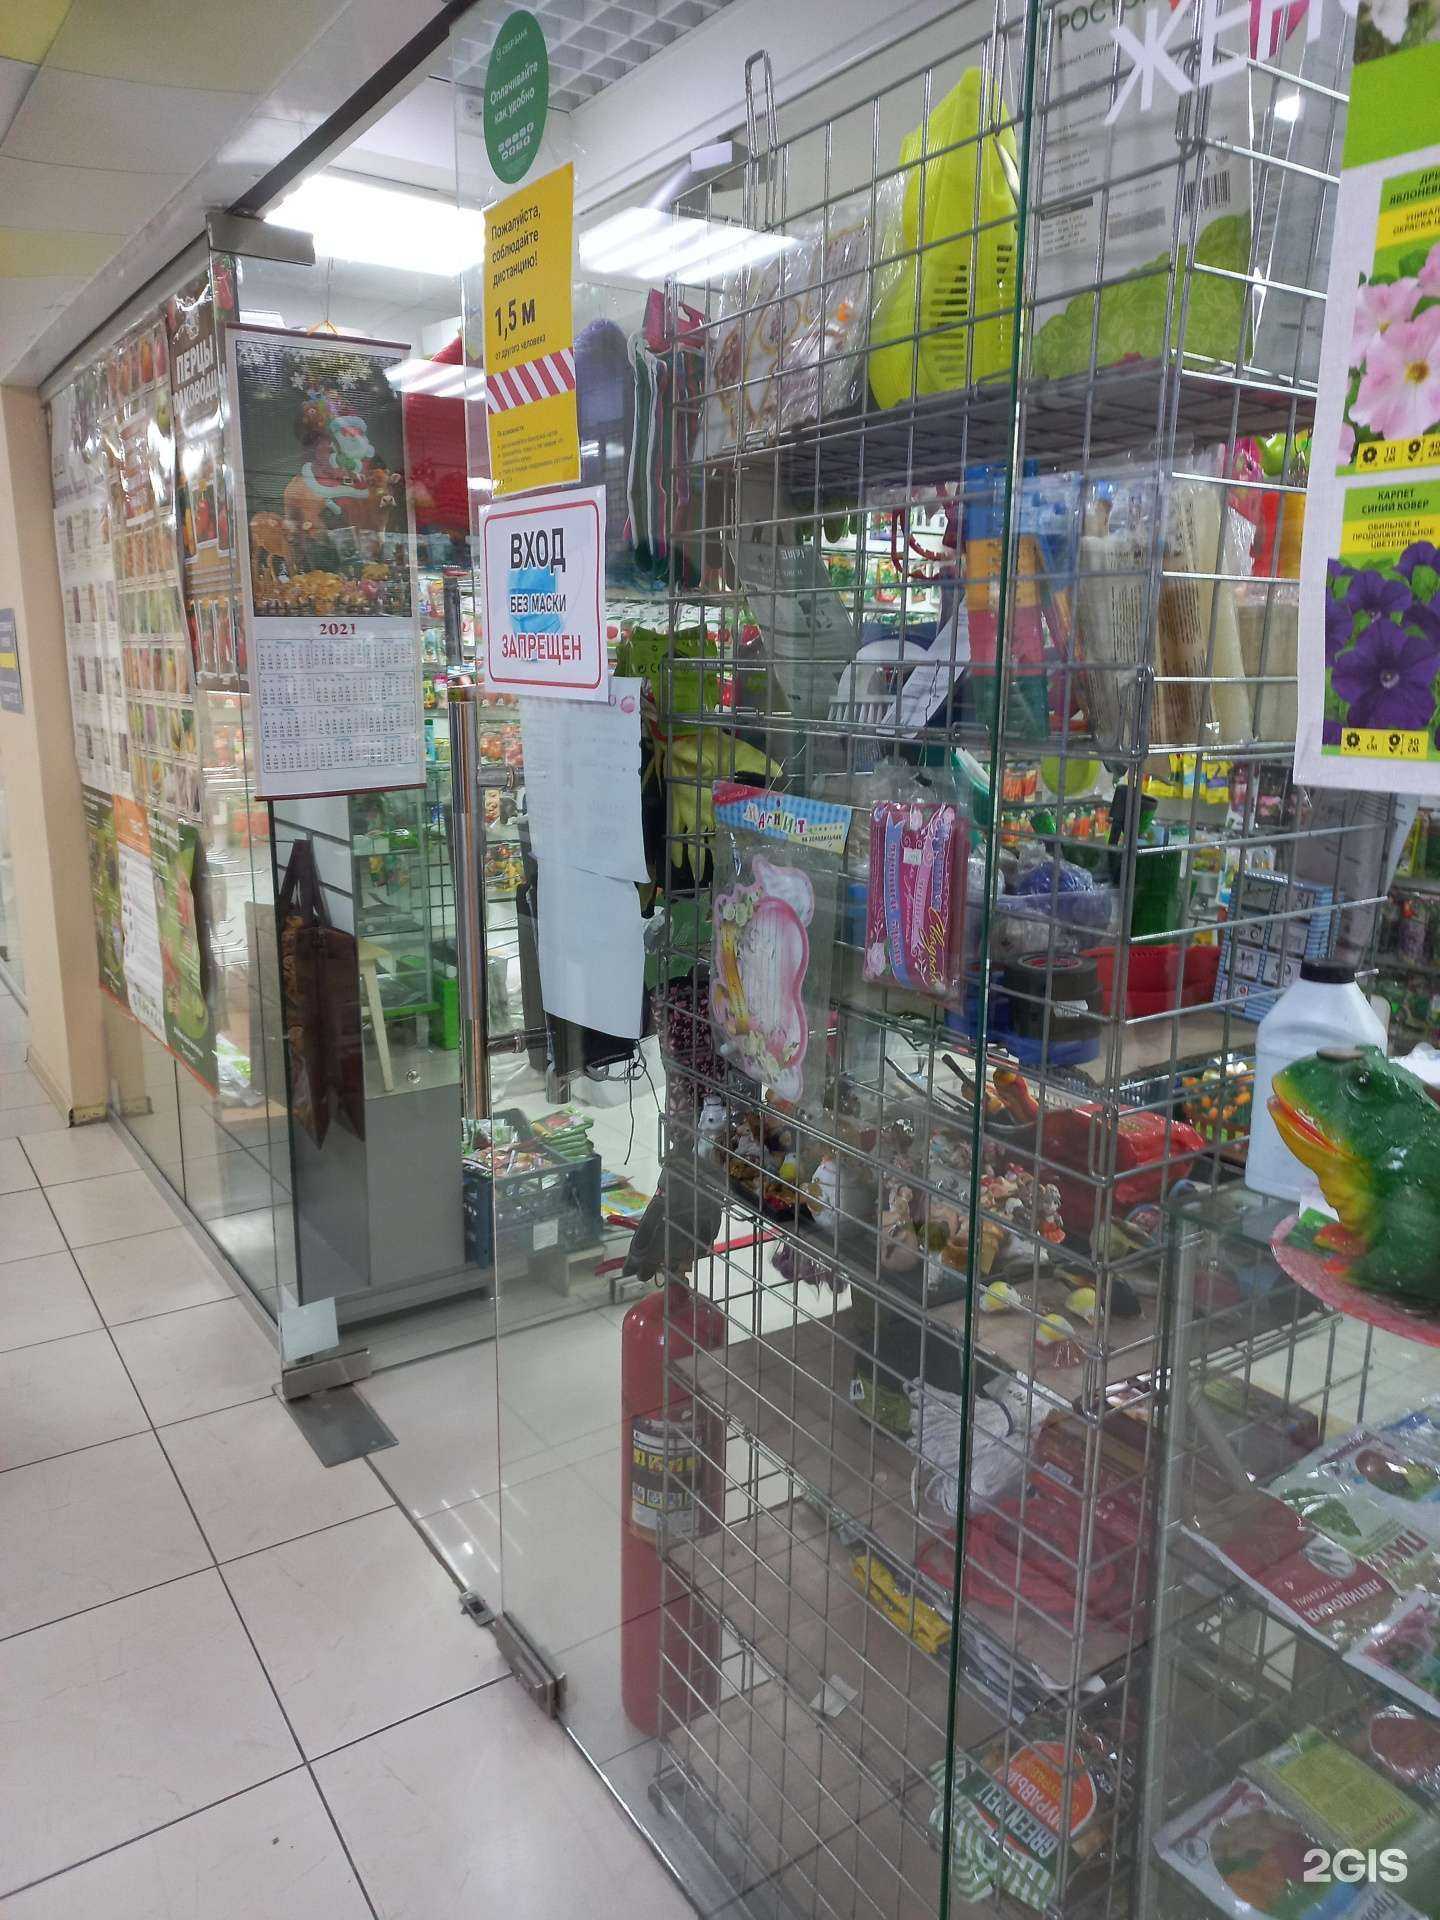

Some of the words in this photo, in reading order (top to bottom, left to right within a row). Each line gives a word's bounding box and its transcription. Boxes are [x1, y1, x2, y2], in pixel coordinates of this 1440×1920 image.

[490, 61, 538, 105] Оплачивайте
[494, 108, 508, 124] как
[508, 87, 535, 118] удобно
[491, 203, 541, 240] Пожалуйста,
[492, 231, 539, 264] соблюдайте
[492, 251, 538, 288] дистанцию!
[494, 299, 518, 341] 1,5
[176, 334, 214, 385] ПЕРЦЫ
[501, 340, 521, 360] другого
[520, 333, 546, 351] человека
[1361, 502, 1396, 515] СИНИЙ
[1396, 498, 1430, 512] КОВЕР
[1377, 487, 1415, 502] КАРПЕТ
[511, 527, 566, 573] ВХОД
[511, 594, 529, 614] БЕЗ
[531, 593, 567, 614] МАСКИ
[319, 622, 357, 635] 2021
[501, 634, 582, 665] ЗАПРЕЩЕН
[1004, 1803, 1060, 1859] GREEN
